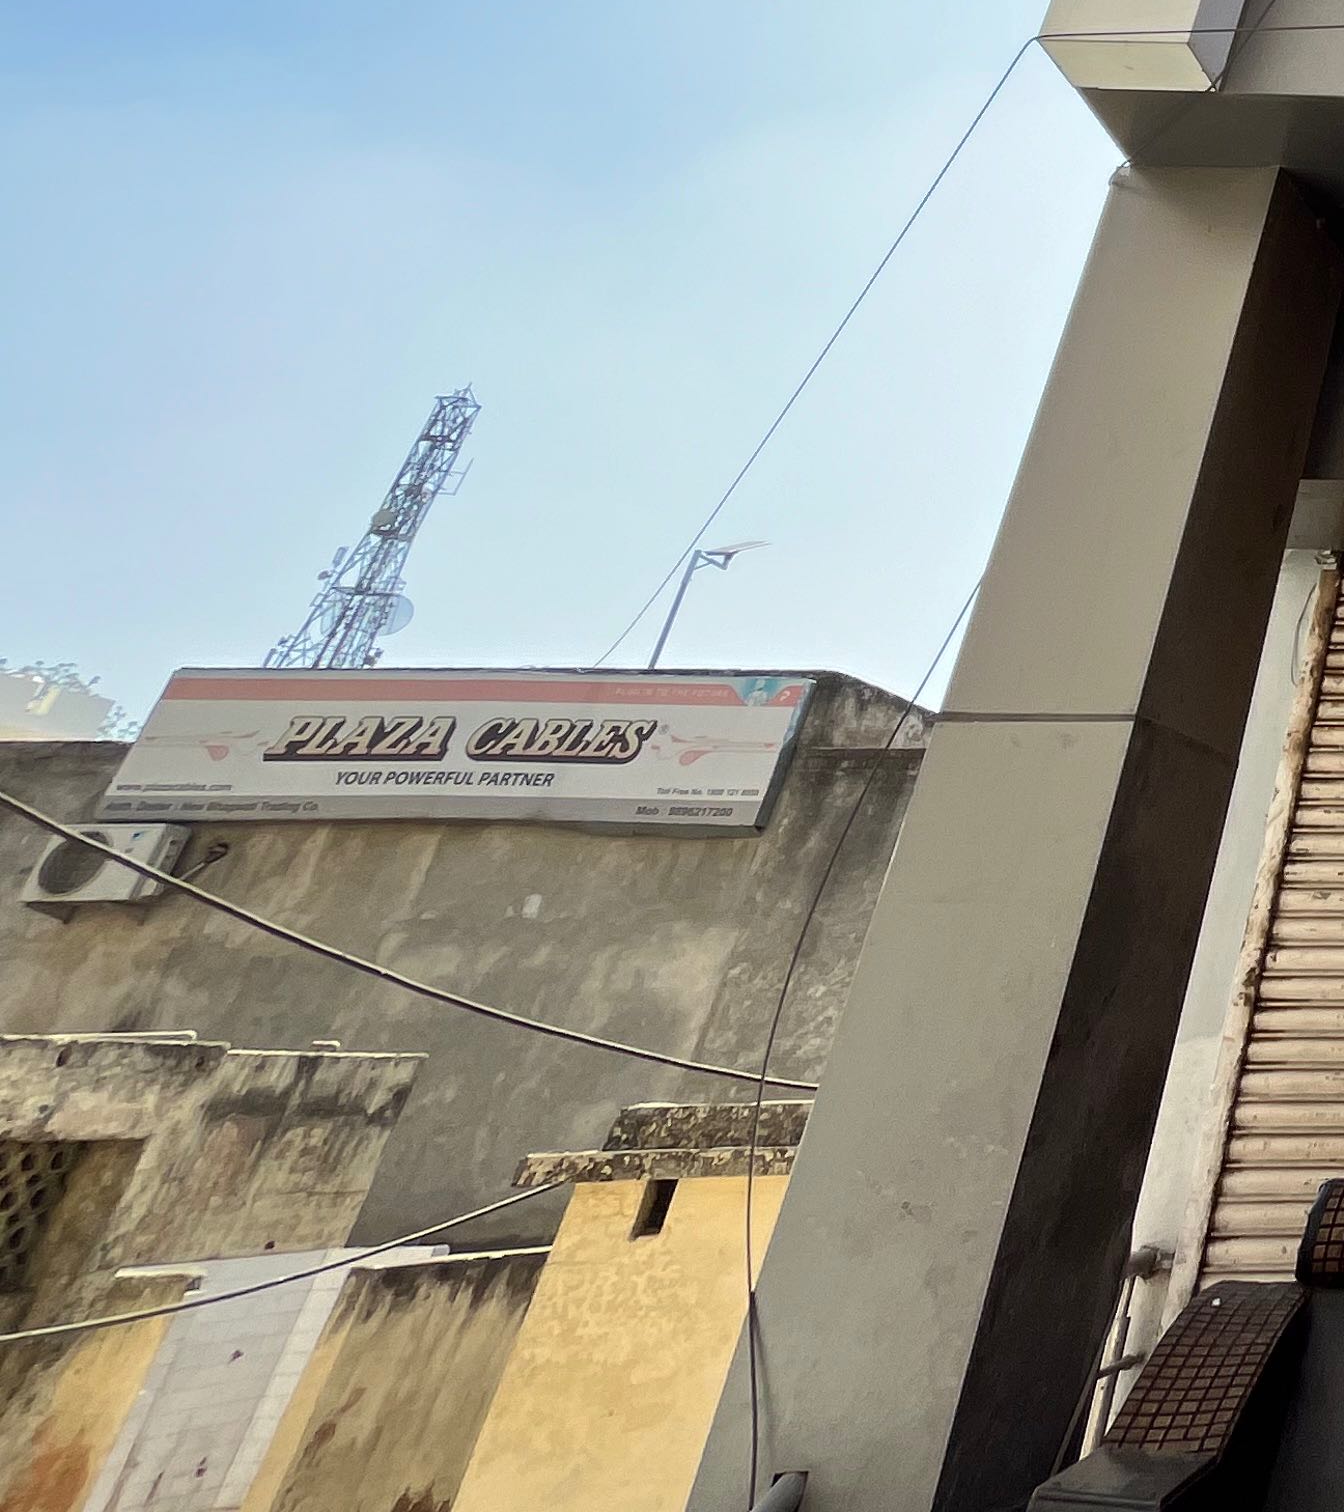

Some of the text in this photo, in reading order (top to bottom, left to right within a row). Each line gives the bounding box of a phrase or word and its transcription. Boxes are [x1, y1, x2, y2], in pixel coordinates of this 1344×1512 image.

[263, 715, 658, 765] PLAZA CABLES
[335, 771, 556, 788] YOUR POWERFUL PARTNER
